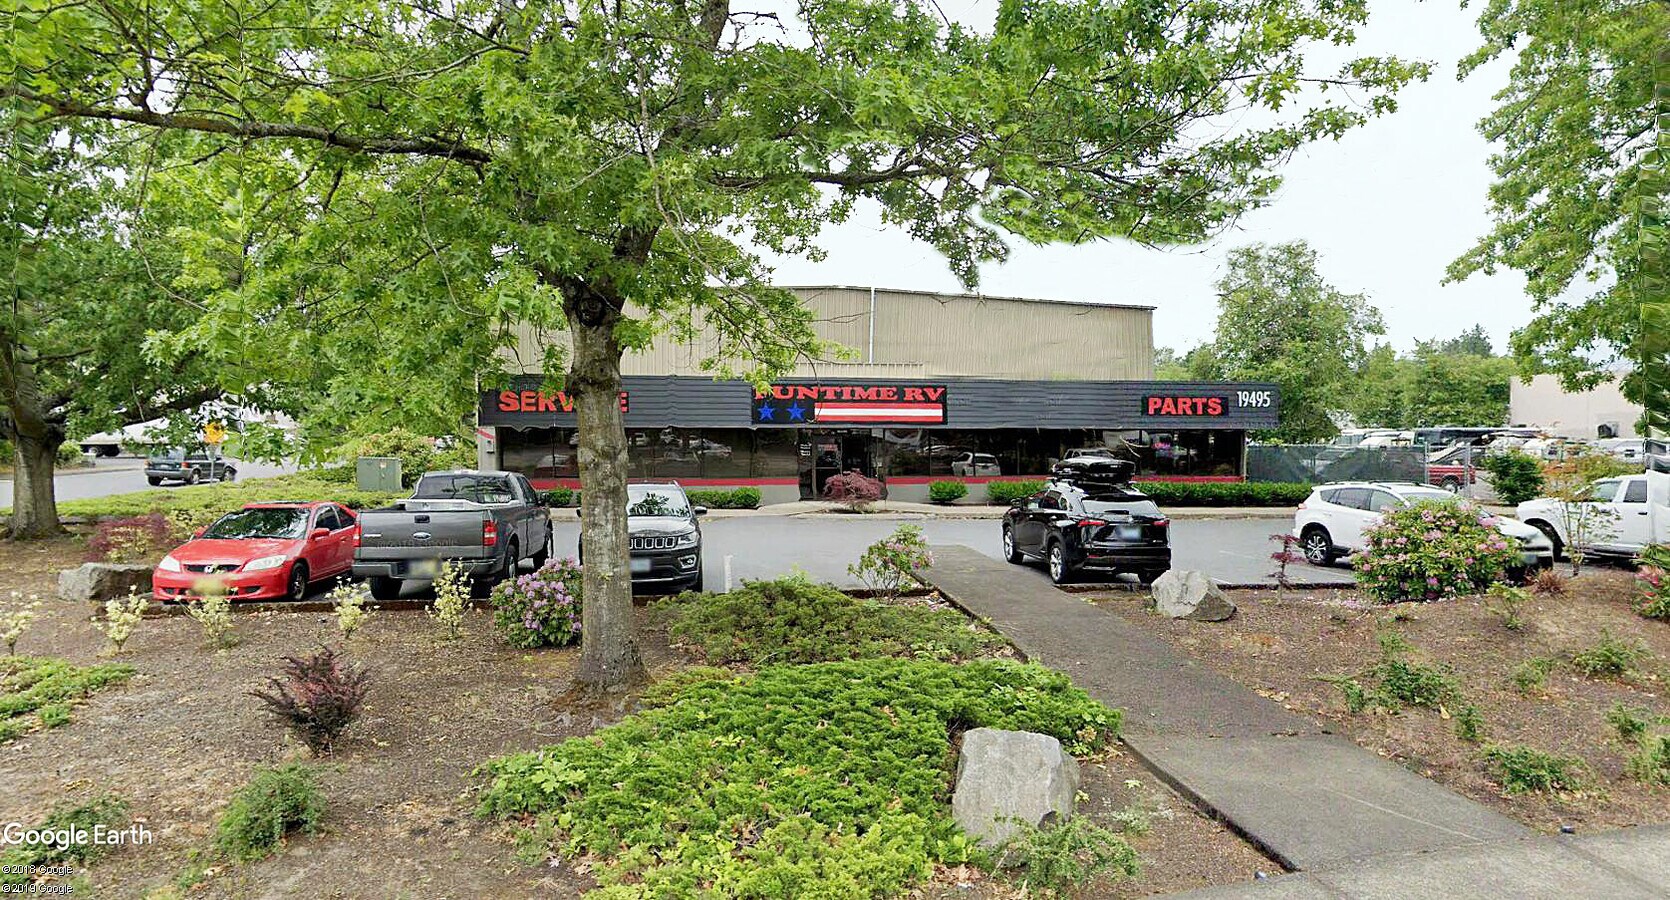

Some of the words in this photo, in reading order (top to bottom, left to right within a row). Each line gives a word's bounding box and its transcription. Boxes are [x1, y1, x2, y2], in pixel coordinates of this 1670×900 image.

[499, 390, 628, 413] SERV
[904, 387, 945, 400] RV
[1236, 391, 1271, 407] 19495
[1148, 397, 1222, 415] PARTS
